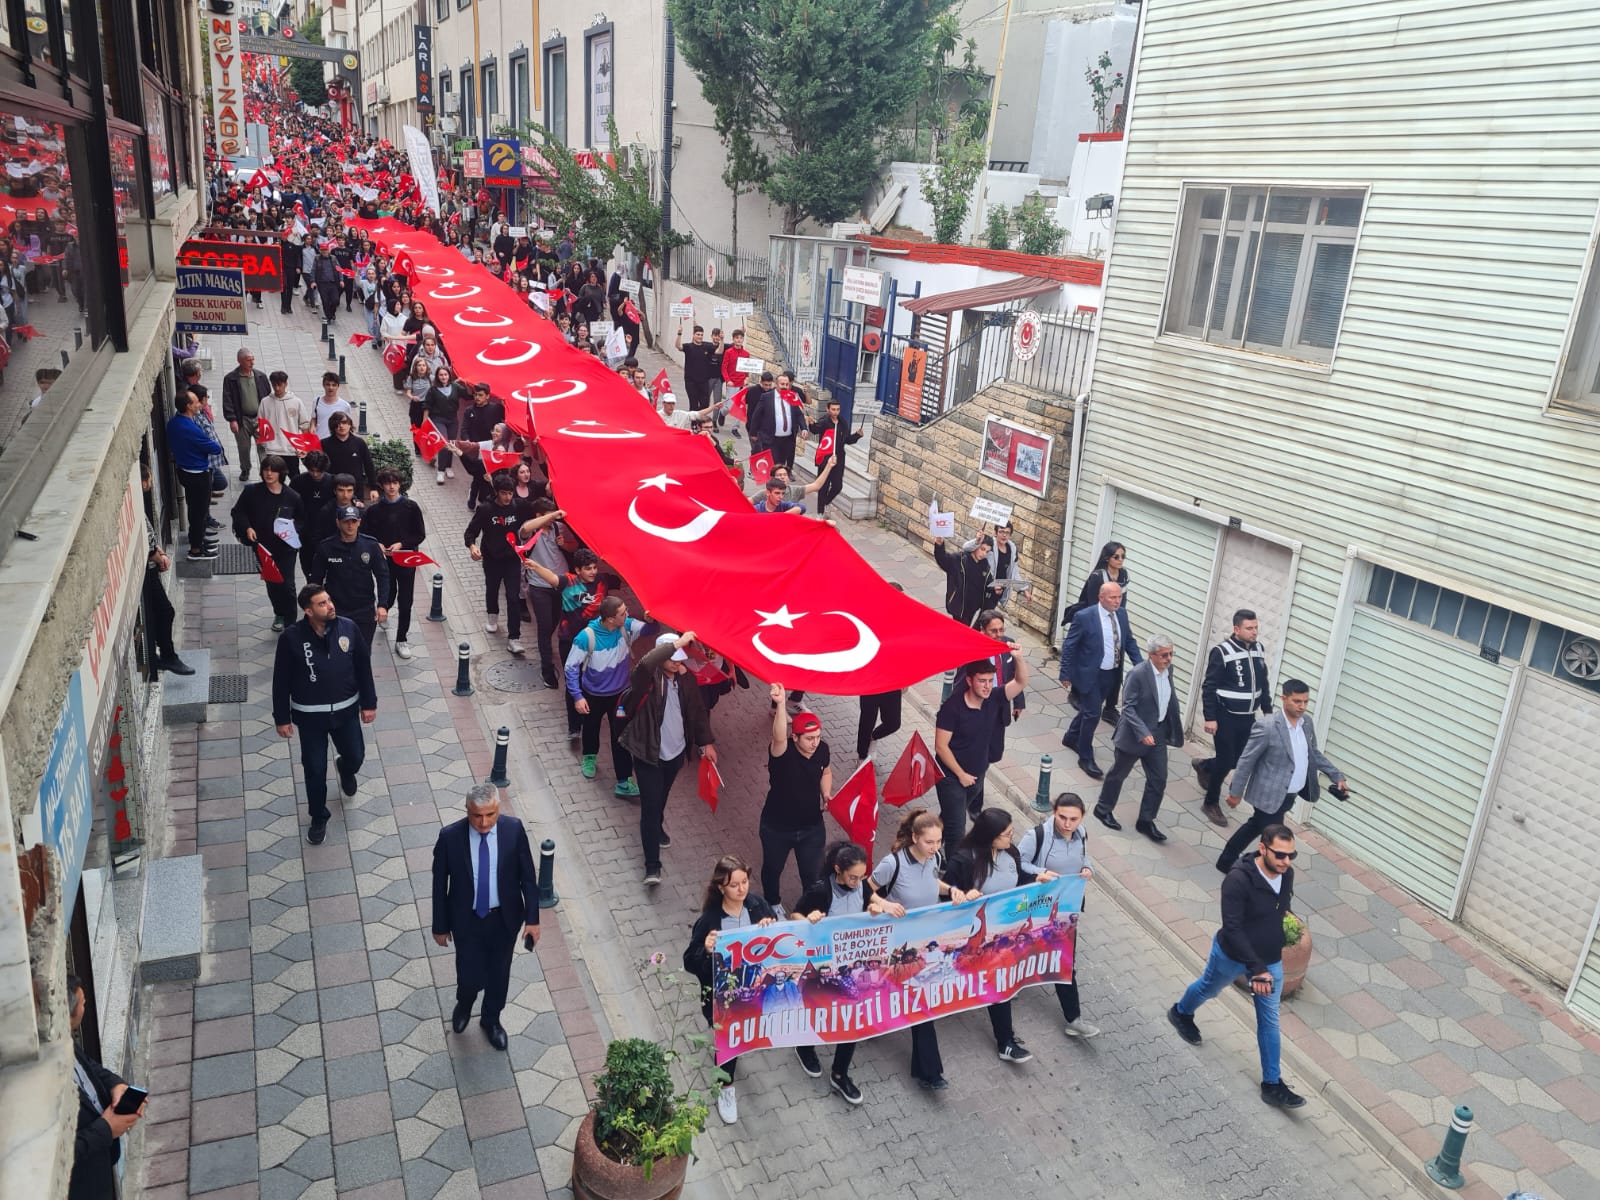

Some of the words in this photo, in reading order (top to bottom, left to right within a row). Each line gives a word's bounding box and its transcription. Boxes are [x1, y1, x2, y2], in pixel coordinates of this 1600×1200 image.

[205, 273, 242, 295] MAKAS
[176, 297, 205, 309] ERKEK
[207, 298, 242, 310] KUAFÖR
[192, 310, 227, 322] SALONU
[226, 324, 237, 332] 14
[836, 946, 888, 964] KAZANDIK
[996, 949, 1063, 993] KURDUK
